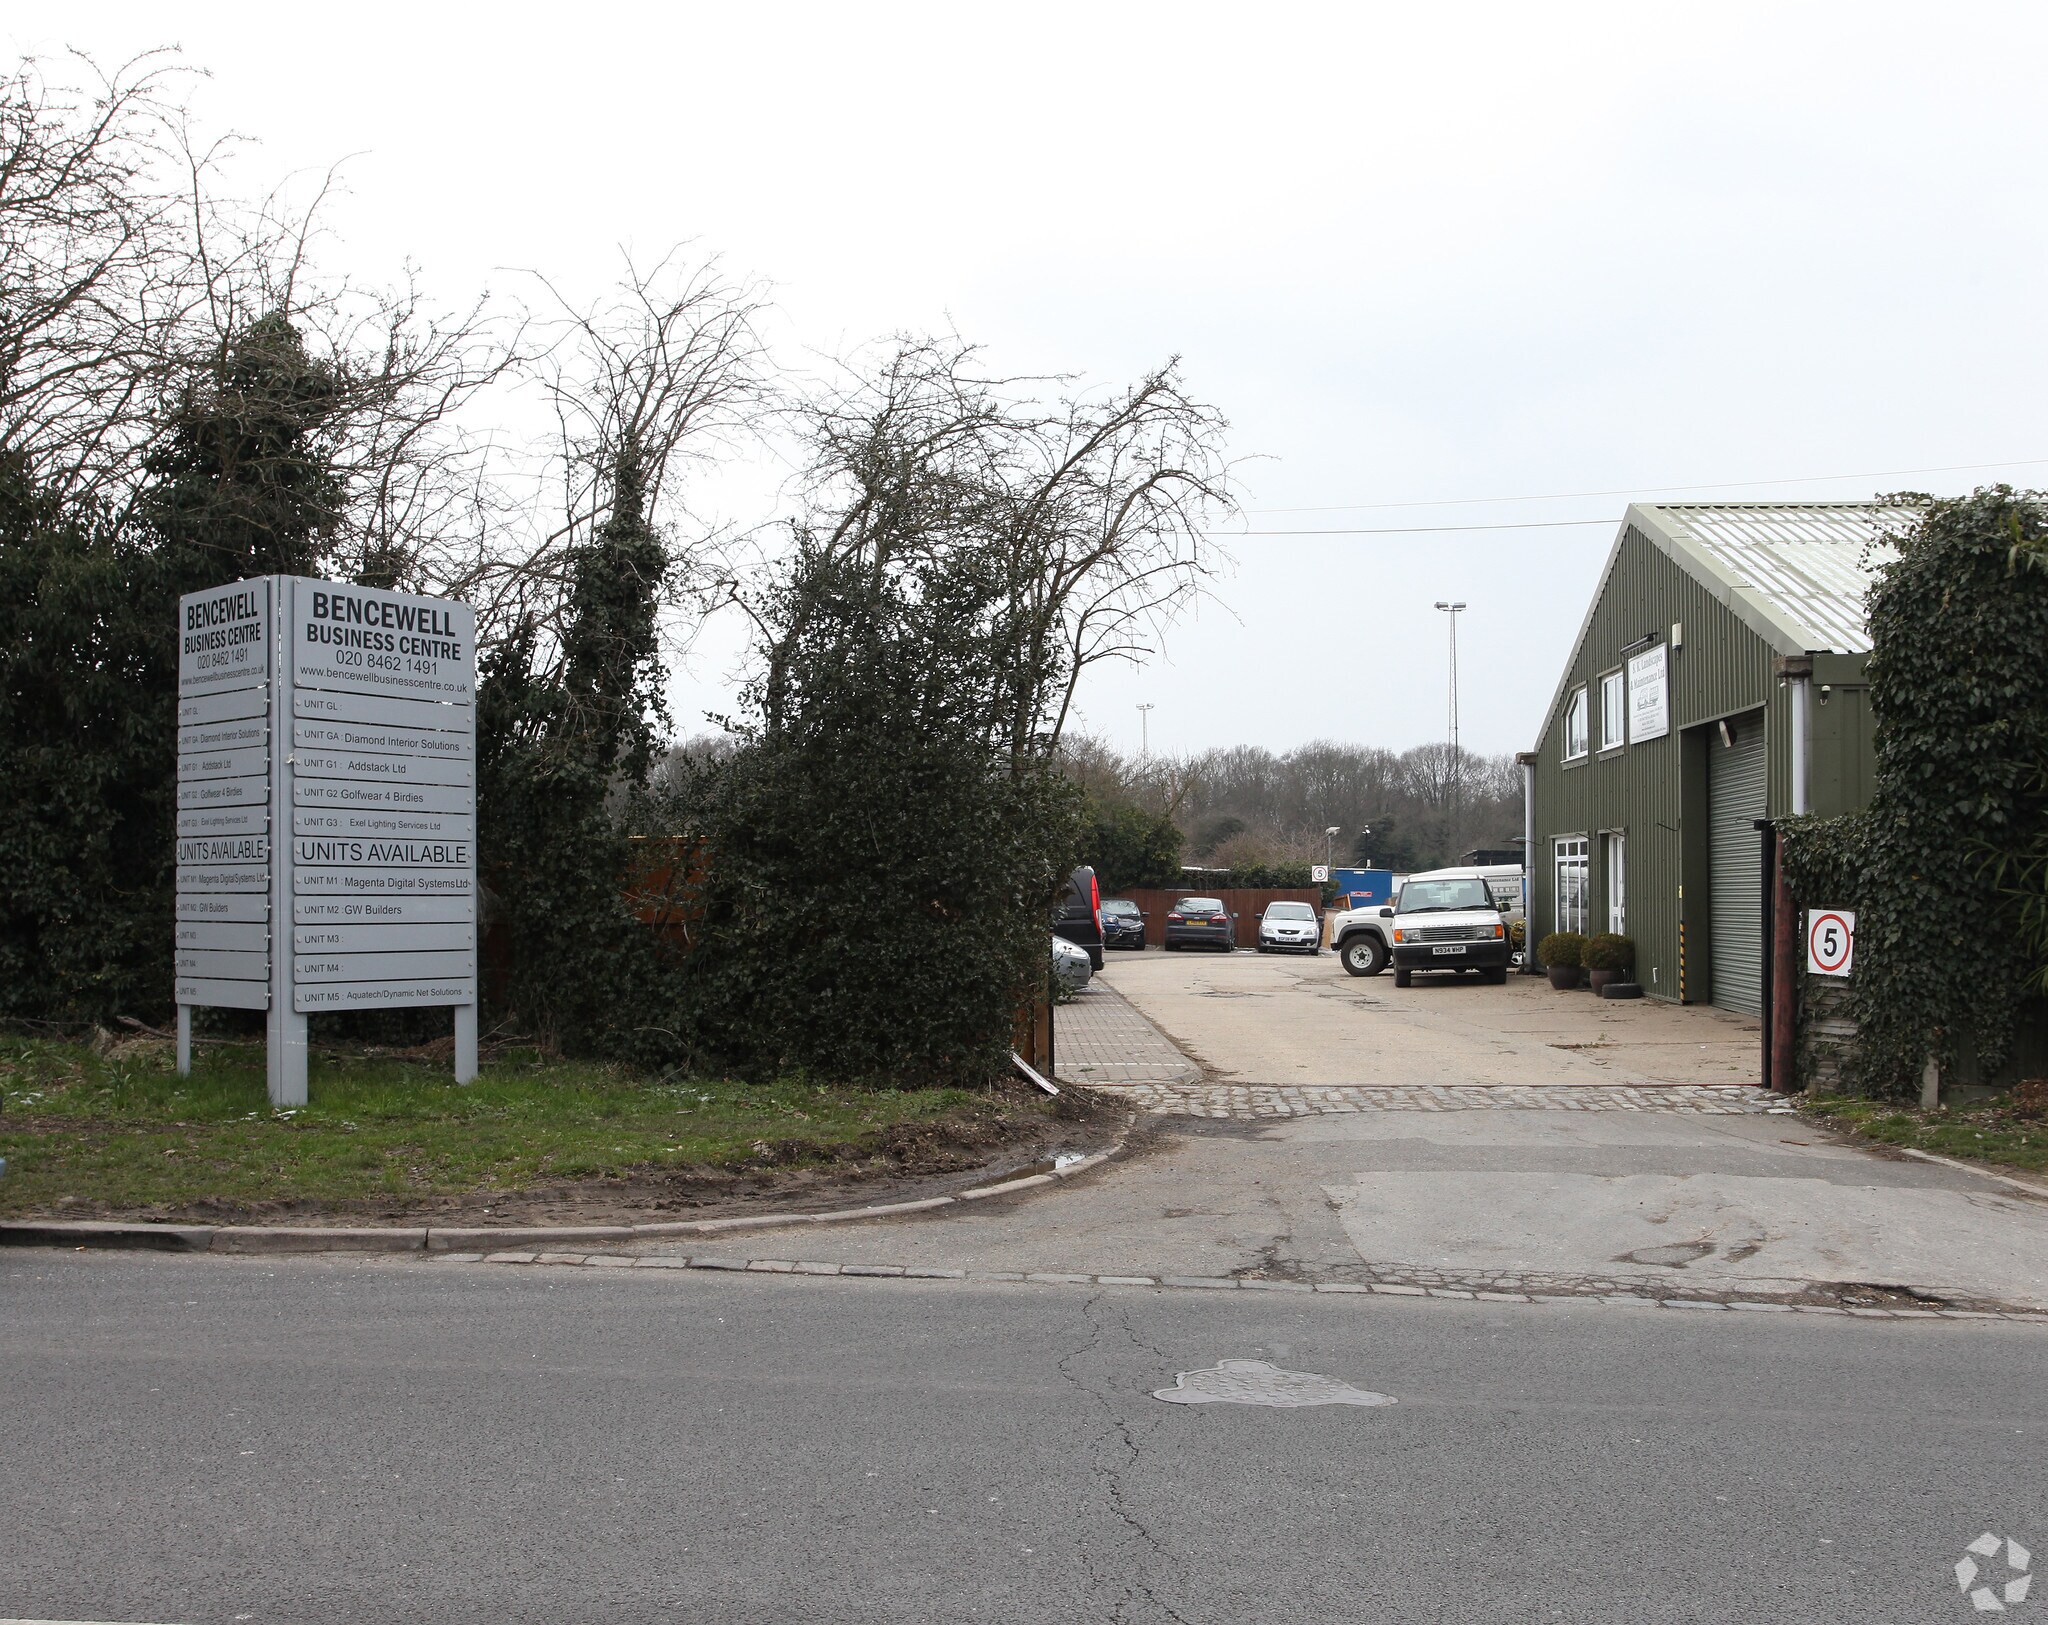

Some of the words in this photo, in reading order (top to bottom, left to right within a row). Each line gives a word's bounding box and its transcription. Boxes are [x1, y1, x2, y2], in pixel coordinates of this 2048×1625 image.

[188, 591, 258, 631] BENCEWELL
[313, 592, 456, 637] BENCEWELL
[185, 630, 226, 654] BUSINESS
[228, 622, 261, 646] CENTRE
[307, 623, 394, 652] BUSINESS
[400, 636, 461, 661] CENTRE
[198, 655, 210, 669] 020
[212, 650, 229, 667] 8462
[231, 647, 248, 663] 1491
[336, 650, 362, 666] 020
[367, 653, 401, 671] 8462
[406, 659, 437, 675] 1491
[1642, 653, 1662, 670] Landscapes
[181, 664, 264, 685] www.bencewellbusinesscentre.co.uk
[300, 666, 467, 693] www.bencewellbusinesscentre.co.uk
[1634, 671, 1657, 690] Maintenance
[304, 700, 323, 709] UNIT
[201, 733, 220, 743] Diamond
[222, 732, 237, 740] Interior
[239, 729, 259, 739] Solutions
[304, 730, 324, 739] UNIT
[345, 733, 385, 746] Diamond
[389, 737, 418, 748] Interior
[421, 740, 460, 751] Solutions
[202, 761, 222, 770] Addstack
[304, 759, 323, 767] UNIT
[348, 761, 389, 773] Addstack
[392, 763, 406, 774] Ltd
[201, 789, 221, 799] Golfwear
[222, 788, 225, 796] 4
[226, 787, 242, 796] Birdies
[304, 788, 324, 797] UNIT
[384, 792, 390, 800] 4
[394, 792, 423, 803] Birdies
[210, 817, 224, 826] Lighting
[225, 816, 240, 824] Services
[304, 818, 324, 826] UNIT
[350, 819, 366, 827] Exel
[368, 819, 396, 830] Lighting
[398, 821, 428, 830] Services
[430, 822, 441, 830] Ltd
[180, 842, 209, 860] UNITS
[211, 840, 263, 859] AVAILABLE
[302, 842, 362, 861] UNITS
[367, 844, 466, 863] AVAILABLE
[199, 874, 219, 886] Magenta
[220, 873, 235, 885] Digital
[235, 873, 255, 885] Systems
[304, 876, 324, 884] UNIT
[345, 877, 385, 889] Magenta
[388, 877, 416, 889] Digital
[418, 878, 455, 889] Systems
[200, 903, 208, 912] GW
[209, 903, 228, 912] Builders
[304, 905, 324, 914] UNIT
[345, 905, 362, 914] GW
[366, 905, 402, 915] Builders
[304, 935, 325, 943] UNIT
[1823, 928, 1837, 957] 5
[304, 964, 324, 973] UNIT
[304, 993, 325, 1002] UNIT
[347, 989, 414, 1000] Aquatech/Dynamic
[430, 987, 462, 996] Solutions
